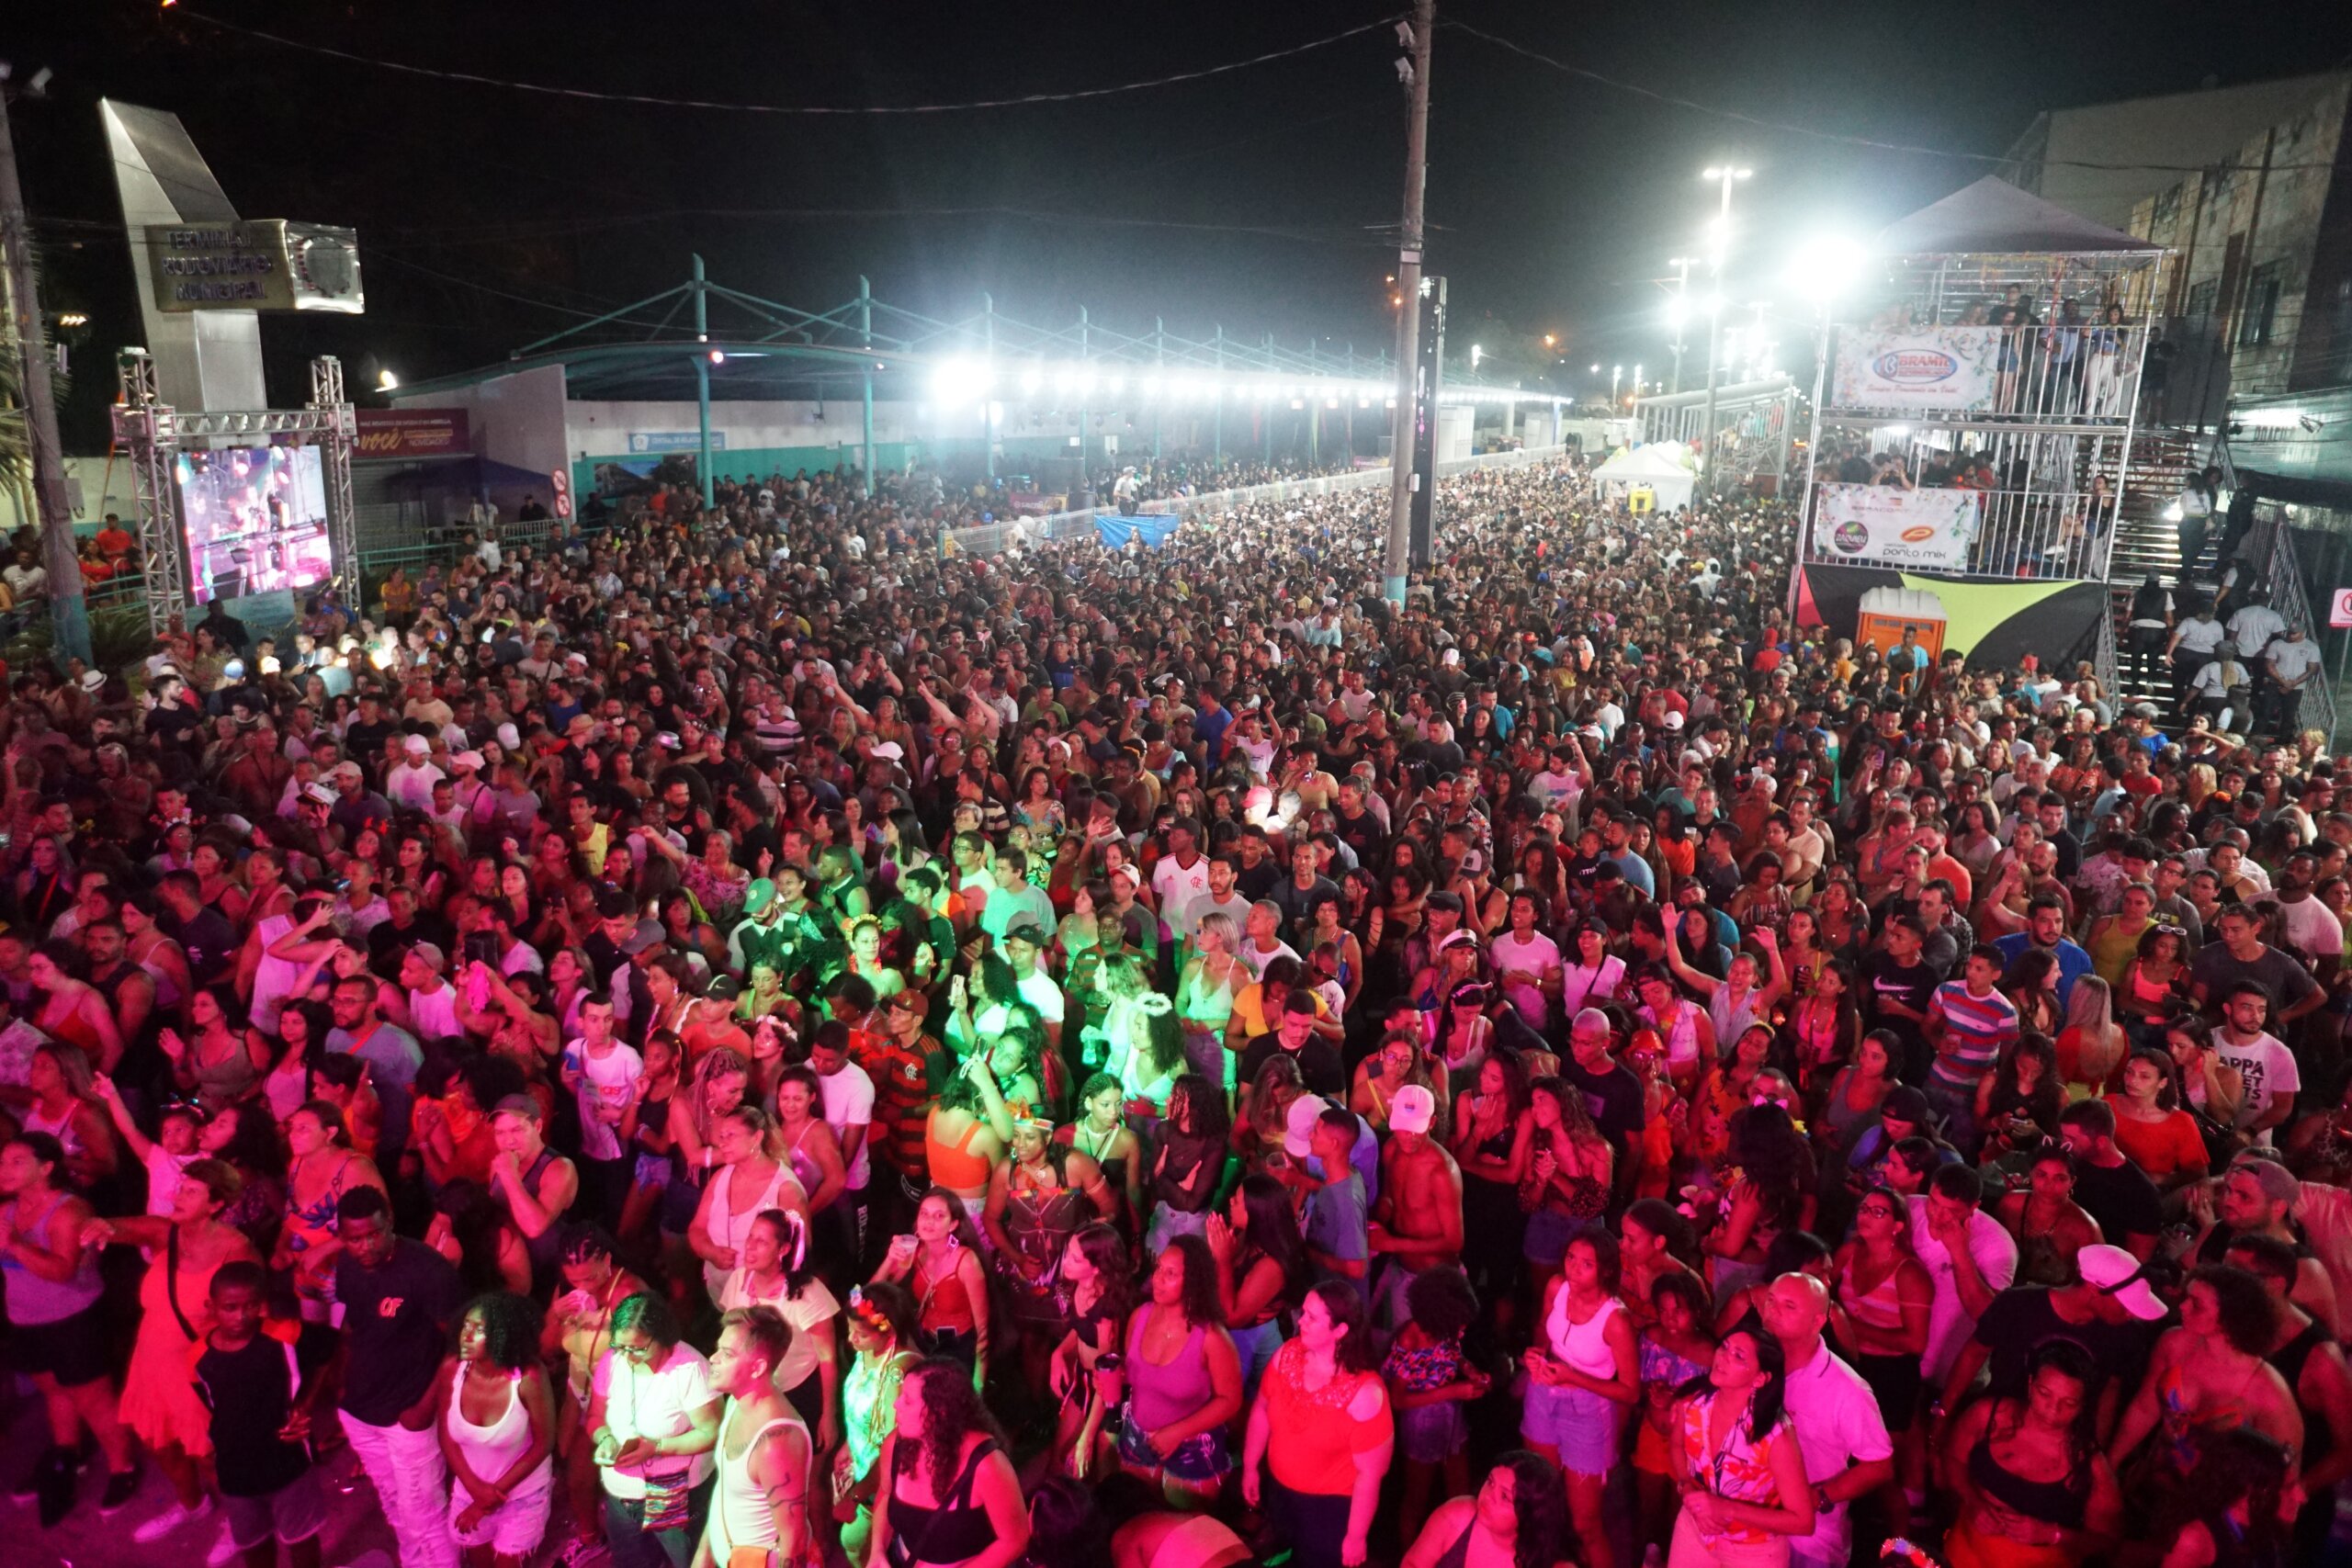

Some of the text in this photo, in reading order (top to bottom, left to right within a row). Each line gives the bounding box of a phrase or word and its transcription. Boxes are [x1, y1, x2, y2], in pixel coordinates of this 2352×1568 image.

[1899, 355, 1950, 367] BRAMIL
[1883, 548, 1946, 558] ponto mix
